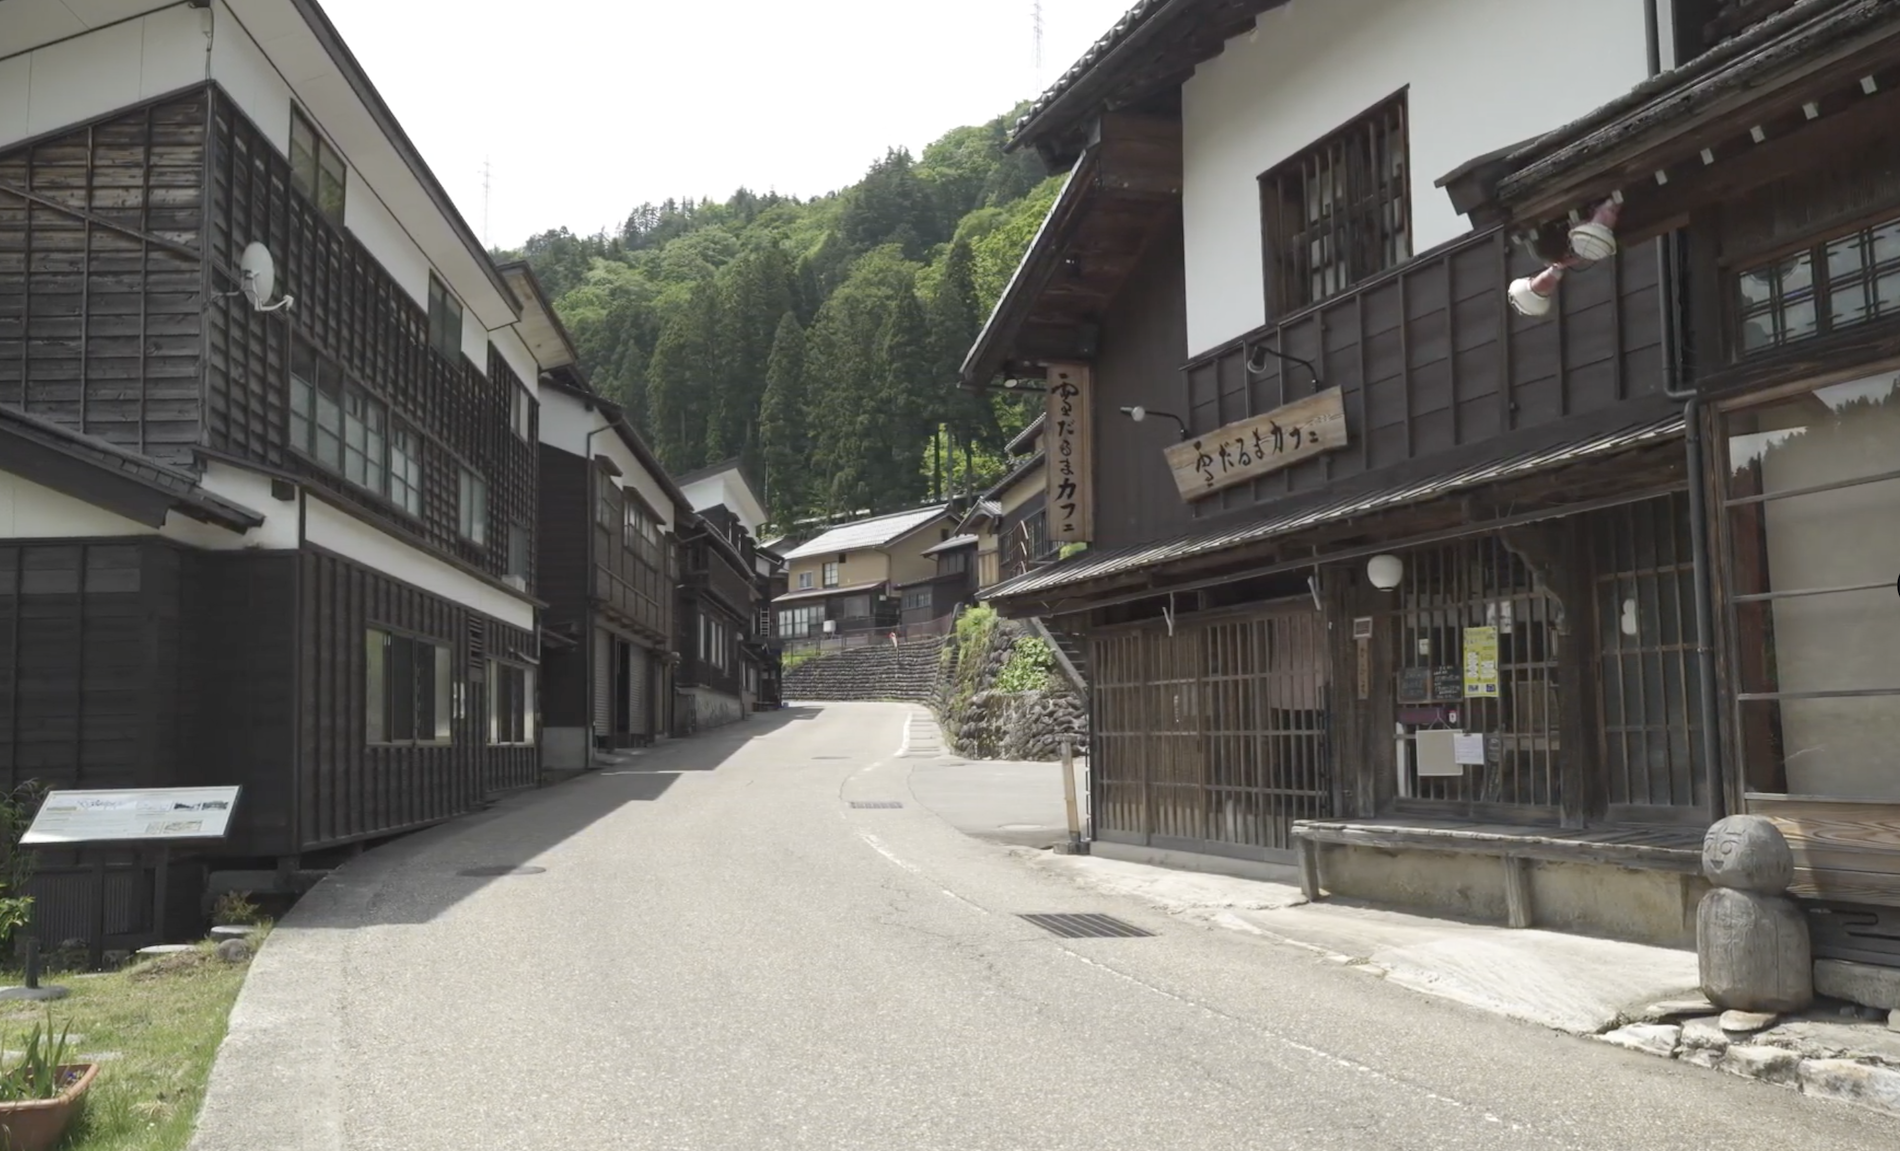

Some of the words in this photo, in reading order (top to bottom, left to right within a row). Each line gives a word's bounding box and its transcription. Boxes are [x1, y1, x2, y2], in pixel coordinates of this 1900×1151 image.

[1051, 373, 1079, 532] 雪だるまカフェ
[1194, 420, 1319, 487] 雪だるまカフェ
